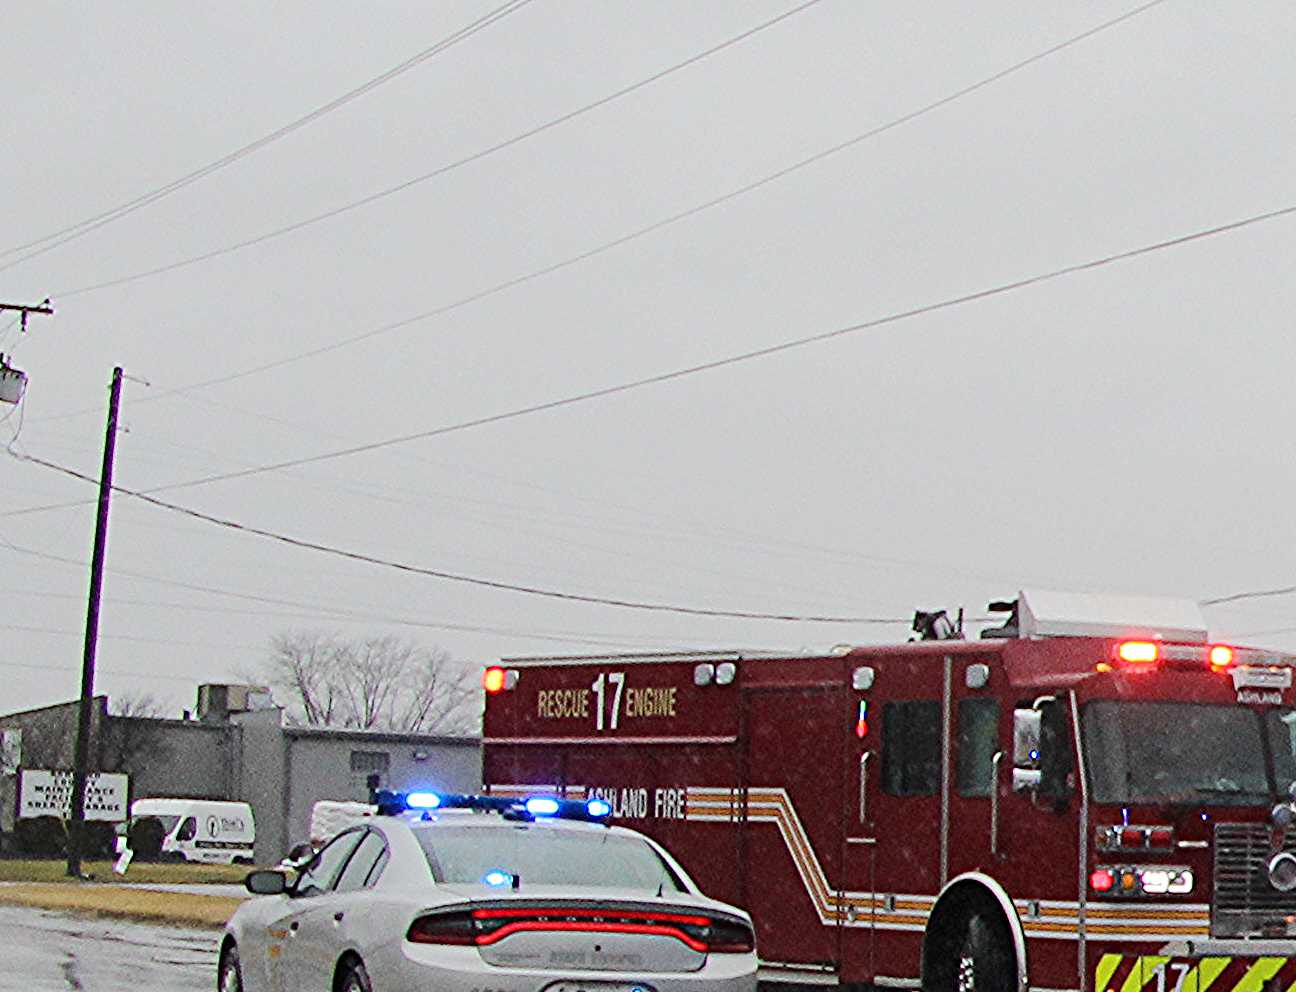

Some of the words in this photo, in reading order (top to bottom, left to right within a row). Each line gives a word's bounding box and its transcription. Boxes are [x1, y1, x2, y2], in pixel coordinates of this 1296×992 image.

[537, 689, 589, 718] RESCUE
[592, 672, 625, 730] 17
[626, 688, 677, 717] ENGINE
[35, 785, 114, 796] MAINTANCE
[655, 788, 685, 819] FIRE
